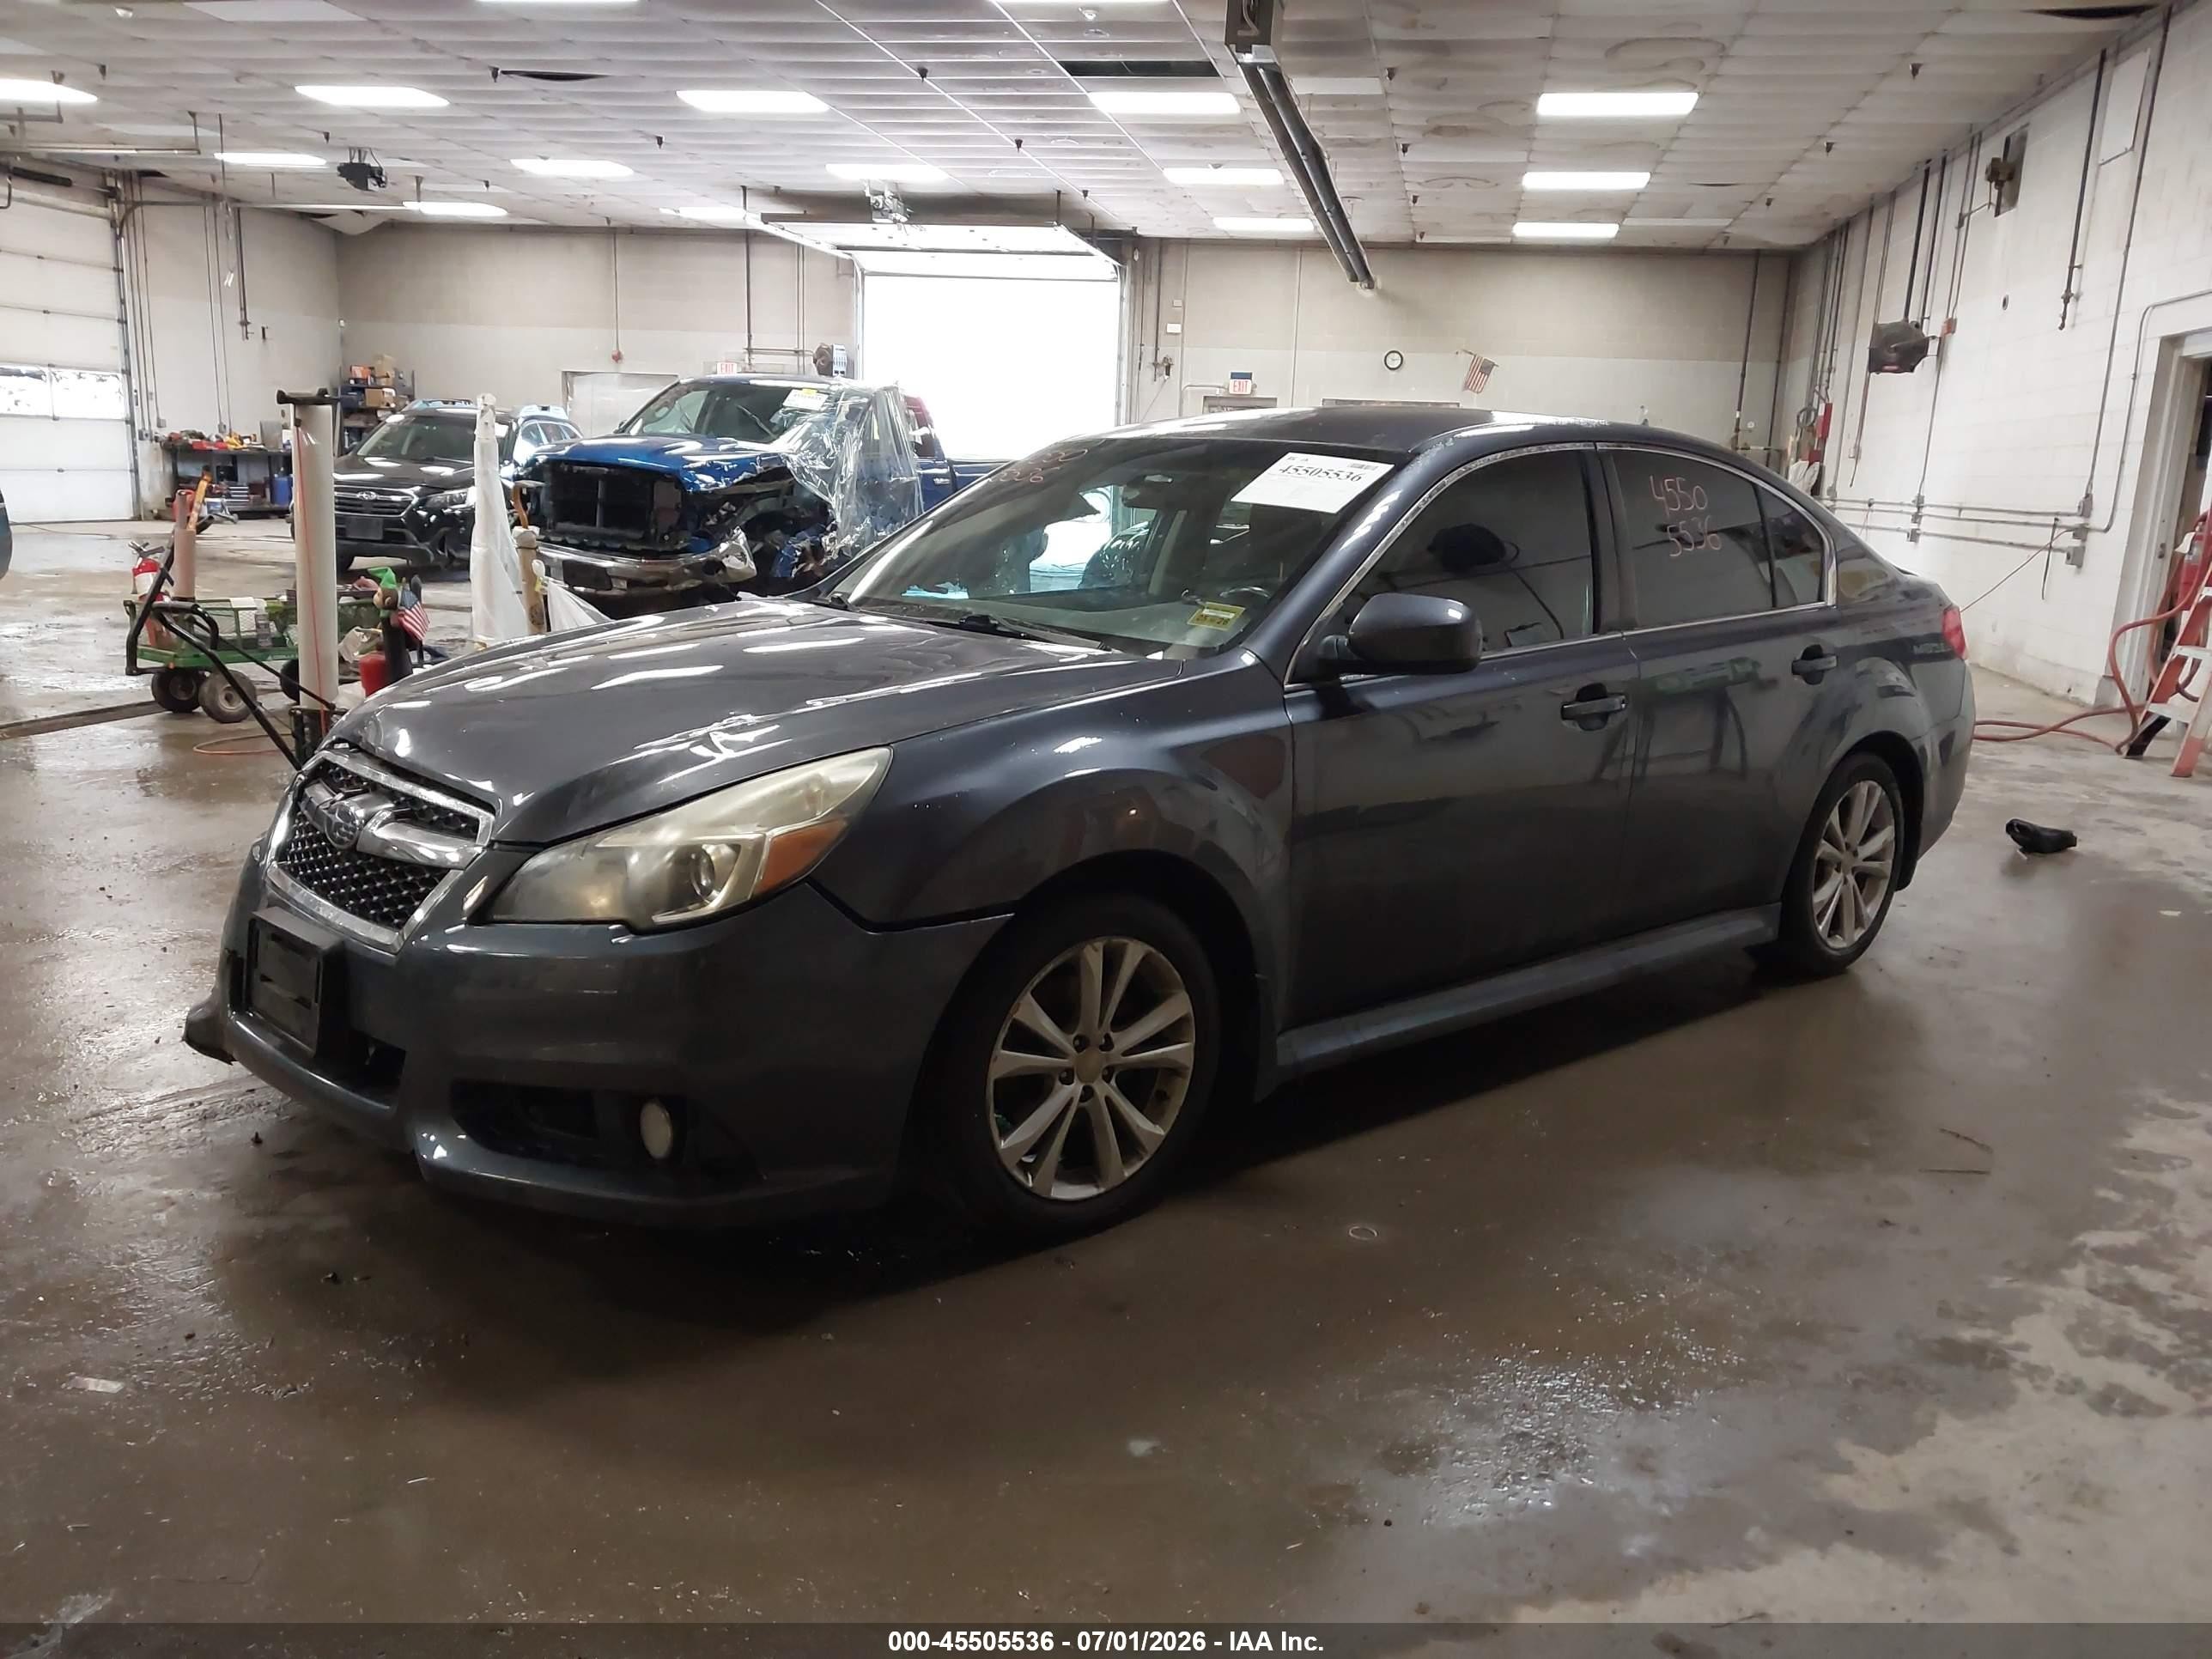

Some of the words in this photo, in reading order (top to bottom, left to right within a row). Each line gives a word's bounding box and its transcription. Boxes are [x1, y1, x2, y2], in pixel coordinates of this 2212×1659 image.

[1233, 380, 1249, 392] EXIT
[1279, 465, 1363, 483] 45505536
[1650, 475, 1708, 518] 4550
[1668, 515, 1722, 556] 5536
